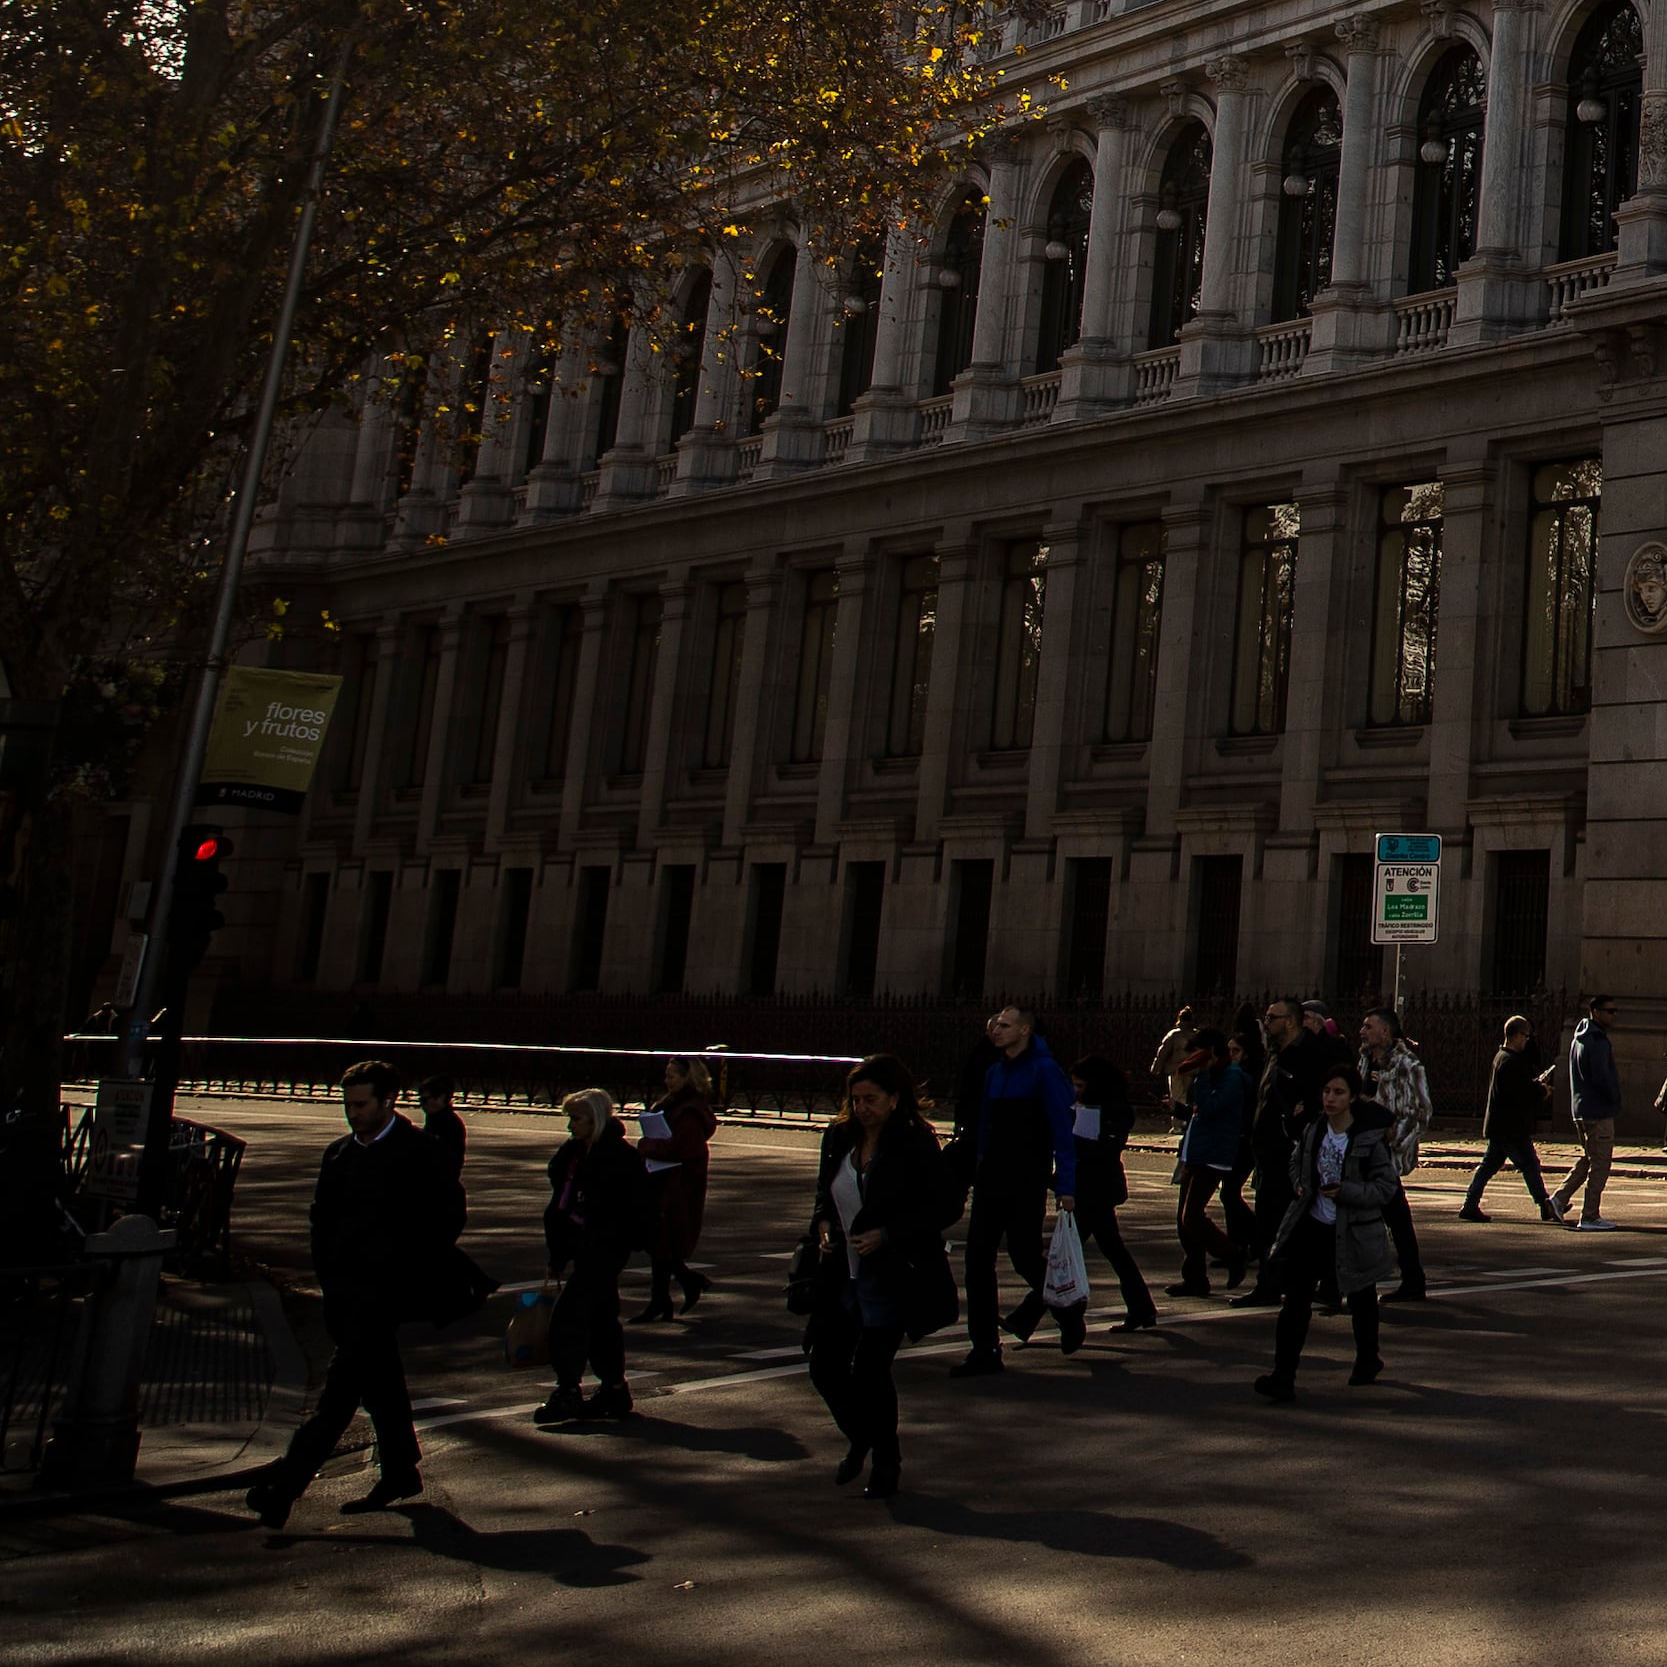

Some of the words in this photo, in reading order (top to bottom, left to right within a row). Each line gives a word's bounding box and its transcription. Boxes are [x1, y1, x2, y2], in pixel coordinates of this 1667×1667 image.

[267, 702, 326, 724] flores
[243, 720, 258, 738] y
[261, 718, 321, 741] frutos
[231, 789, 275, 802] MADRID
[1385, 865, 1432, 877] ATENCIÓN
